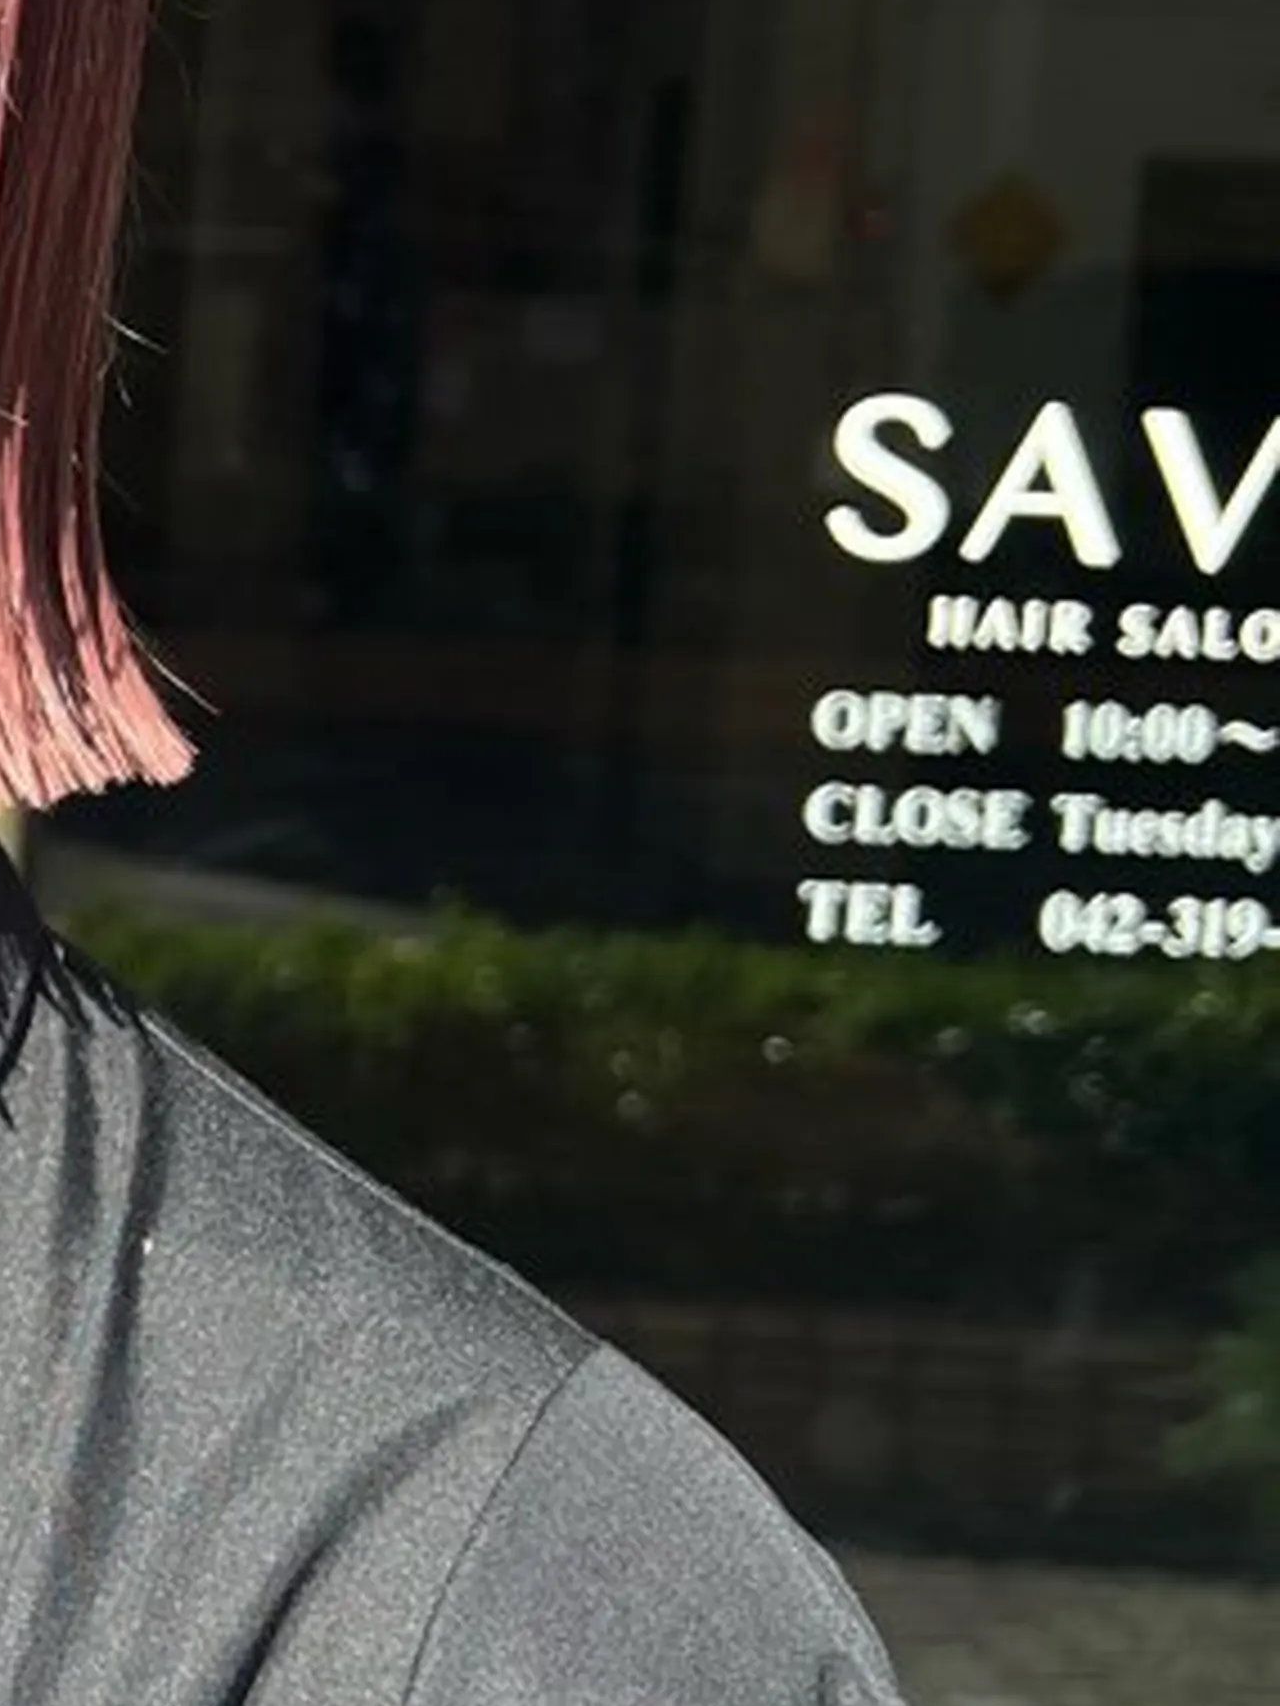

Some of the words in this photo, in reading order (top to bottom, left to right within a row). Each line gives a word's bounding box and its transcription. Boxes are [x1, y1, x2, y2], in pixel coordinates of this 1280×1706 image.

[926, 594, 1094, 656] HAIR
[810, 689, 1002, 755] OPEN
[802, 781, 1034, 850] CLOSE
[1050, 793, 1280, 874] Tuesday
[796, 879, 942, 948] TEL
